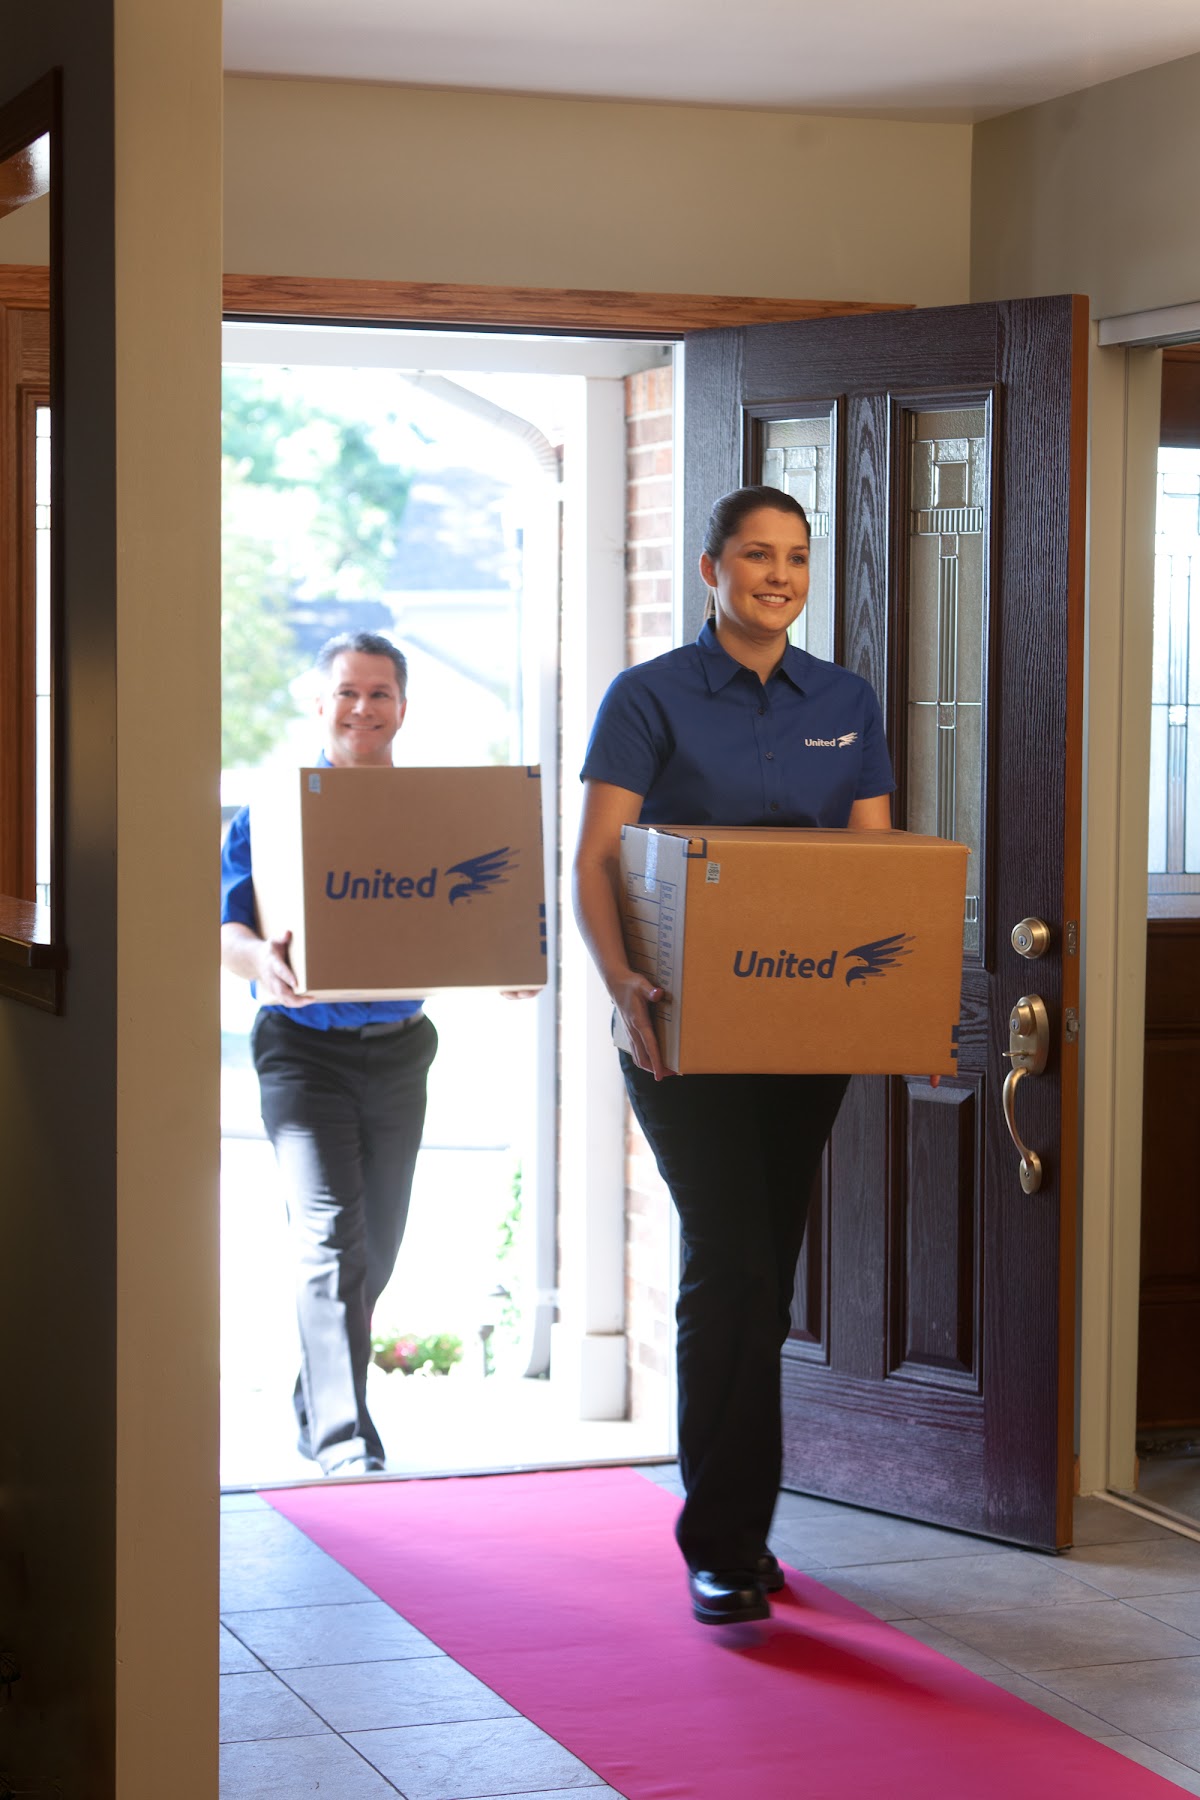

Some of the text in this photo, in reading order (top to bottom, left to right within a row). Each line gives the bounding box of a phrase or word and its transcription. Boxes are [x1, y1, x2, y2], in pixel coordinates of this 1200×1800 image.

[804, 738, 836, 747] United
[325, 867, 438, 900] United
[733, 949, 838, 979] United
